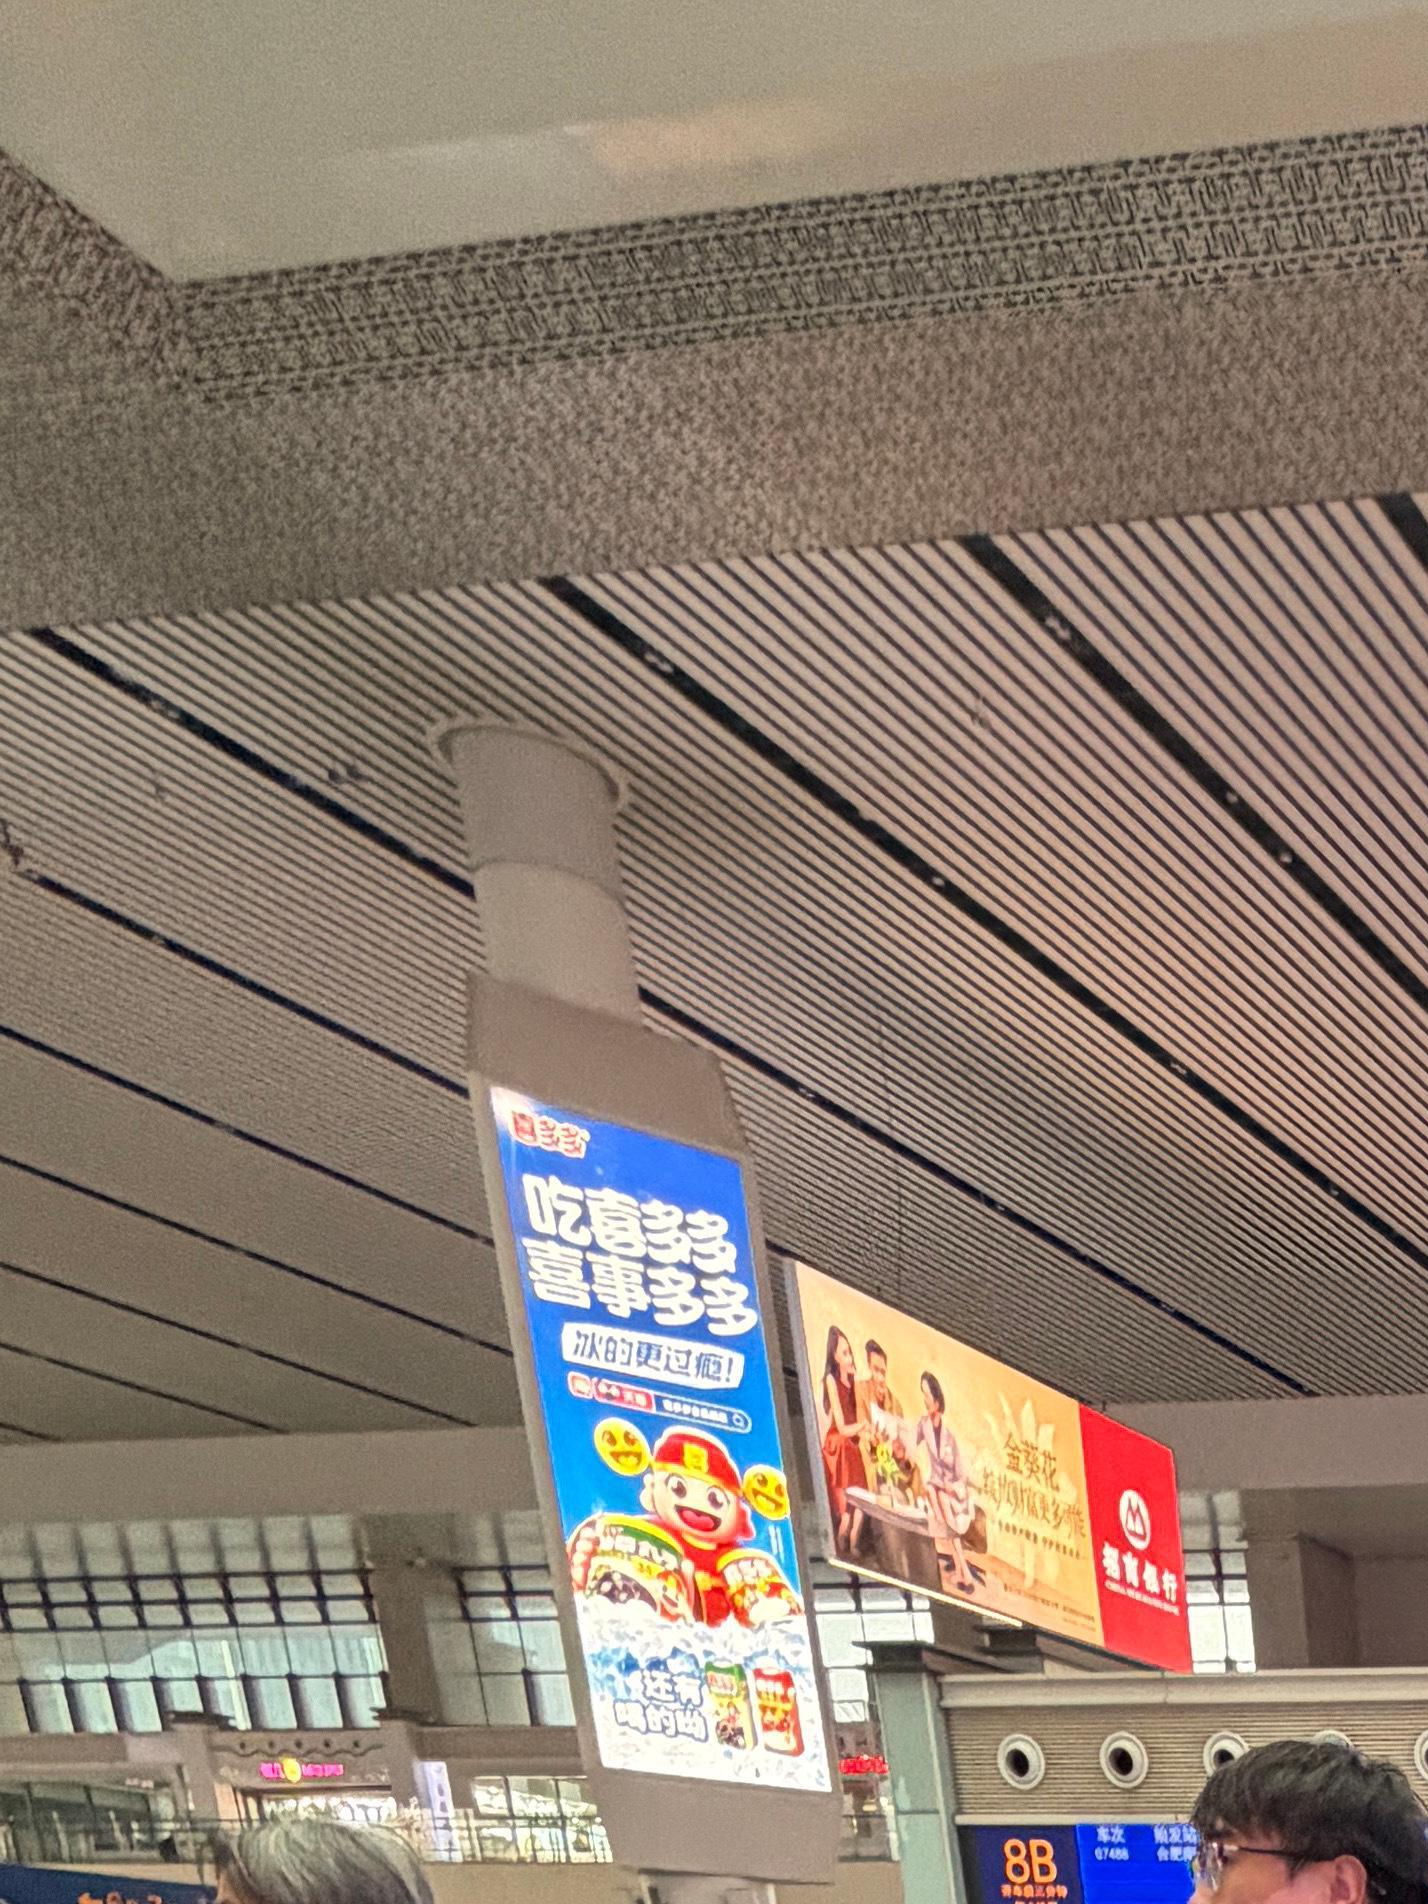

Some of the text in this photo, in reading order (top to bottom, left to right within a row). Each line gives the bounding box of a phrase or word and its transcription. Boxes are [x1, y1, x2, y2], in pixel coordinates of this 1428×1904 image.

[522, 1173, 737, 1274] 吃喜多多
[521, 1237, 758, 1337] 喜事多多
[1003, 1432, 1060, 1492] 金葵花
[1102, 1541, 1178, 1602] 招商银行
[642, 1668, 704, 1708] 还有
[1004, 1838, 1057, 1884] 8B
[1097, 1826, 1125, 1844] 车次
